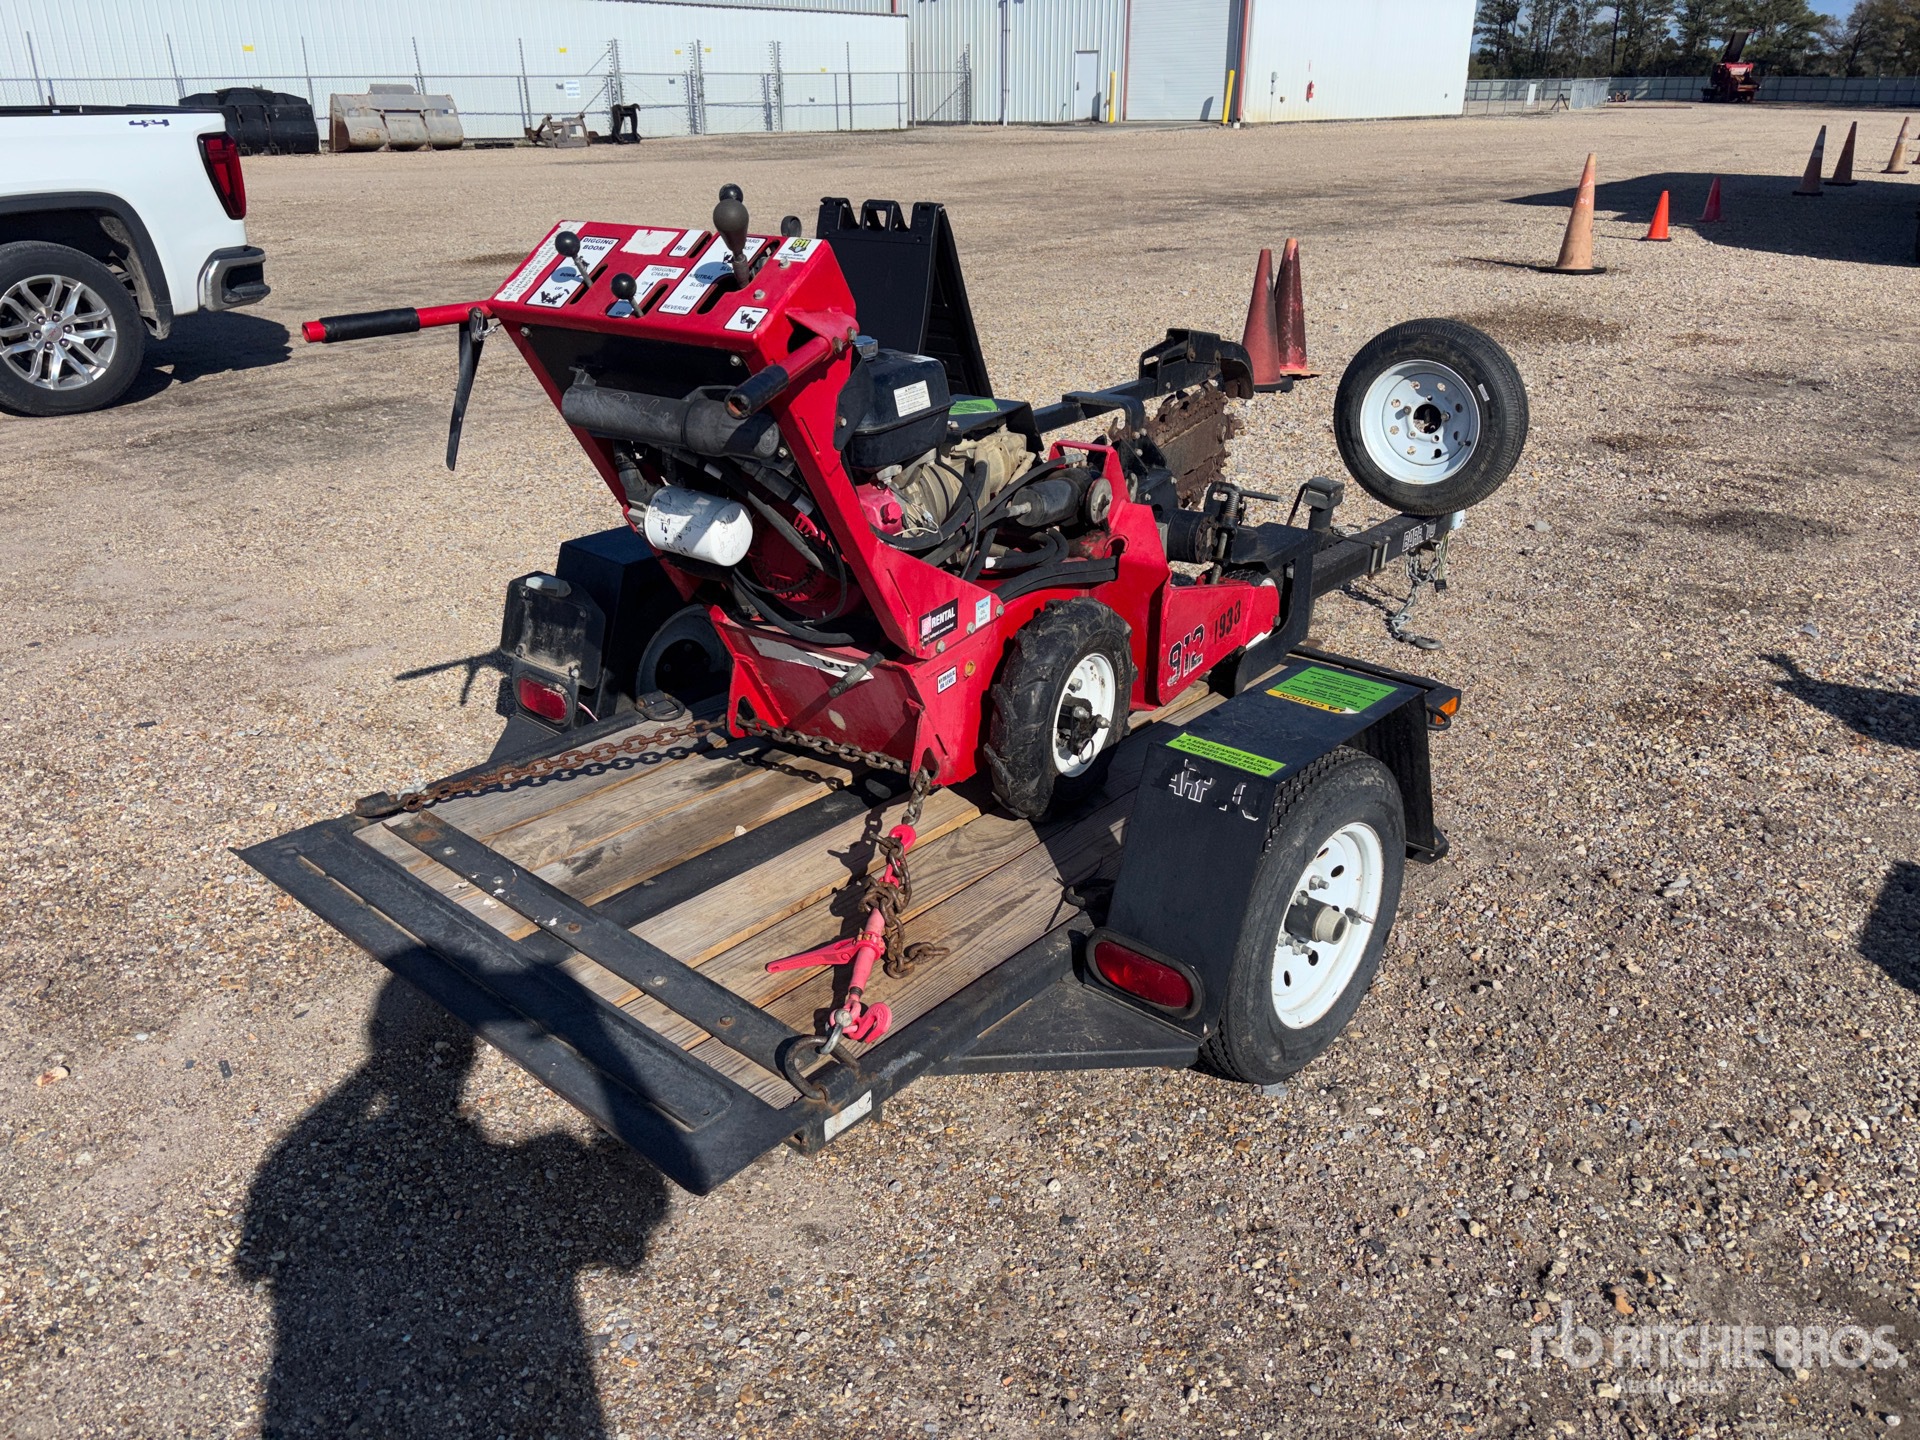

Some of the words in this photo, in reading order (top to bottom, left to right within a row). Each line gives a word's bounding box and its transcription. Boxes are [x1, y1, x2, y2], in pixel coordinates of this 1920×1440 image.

[792, 239, 810, 248] 811
[932, 607, 956, 628] RENTAL
[1167, 624, 1204, 686] 912
[1280, 692, 1324, 708] CAUTION
[1186, 741, 1220, 754] CHARGED
[1242, 759, 1274, 771] MACHINE
[1206, 744, 1242, 756] CLEANING
[1200, 750, 1238, 764] RETURNED
[1237, 762, 1262, 772] CLEAN
